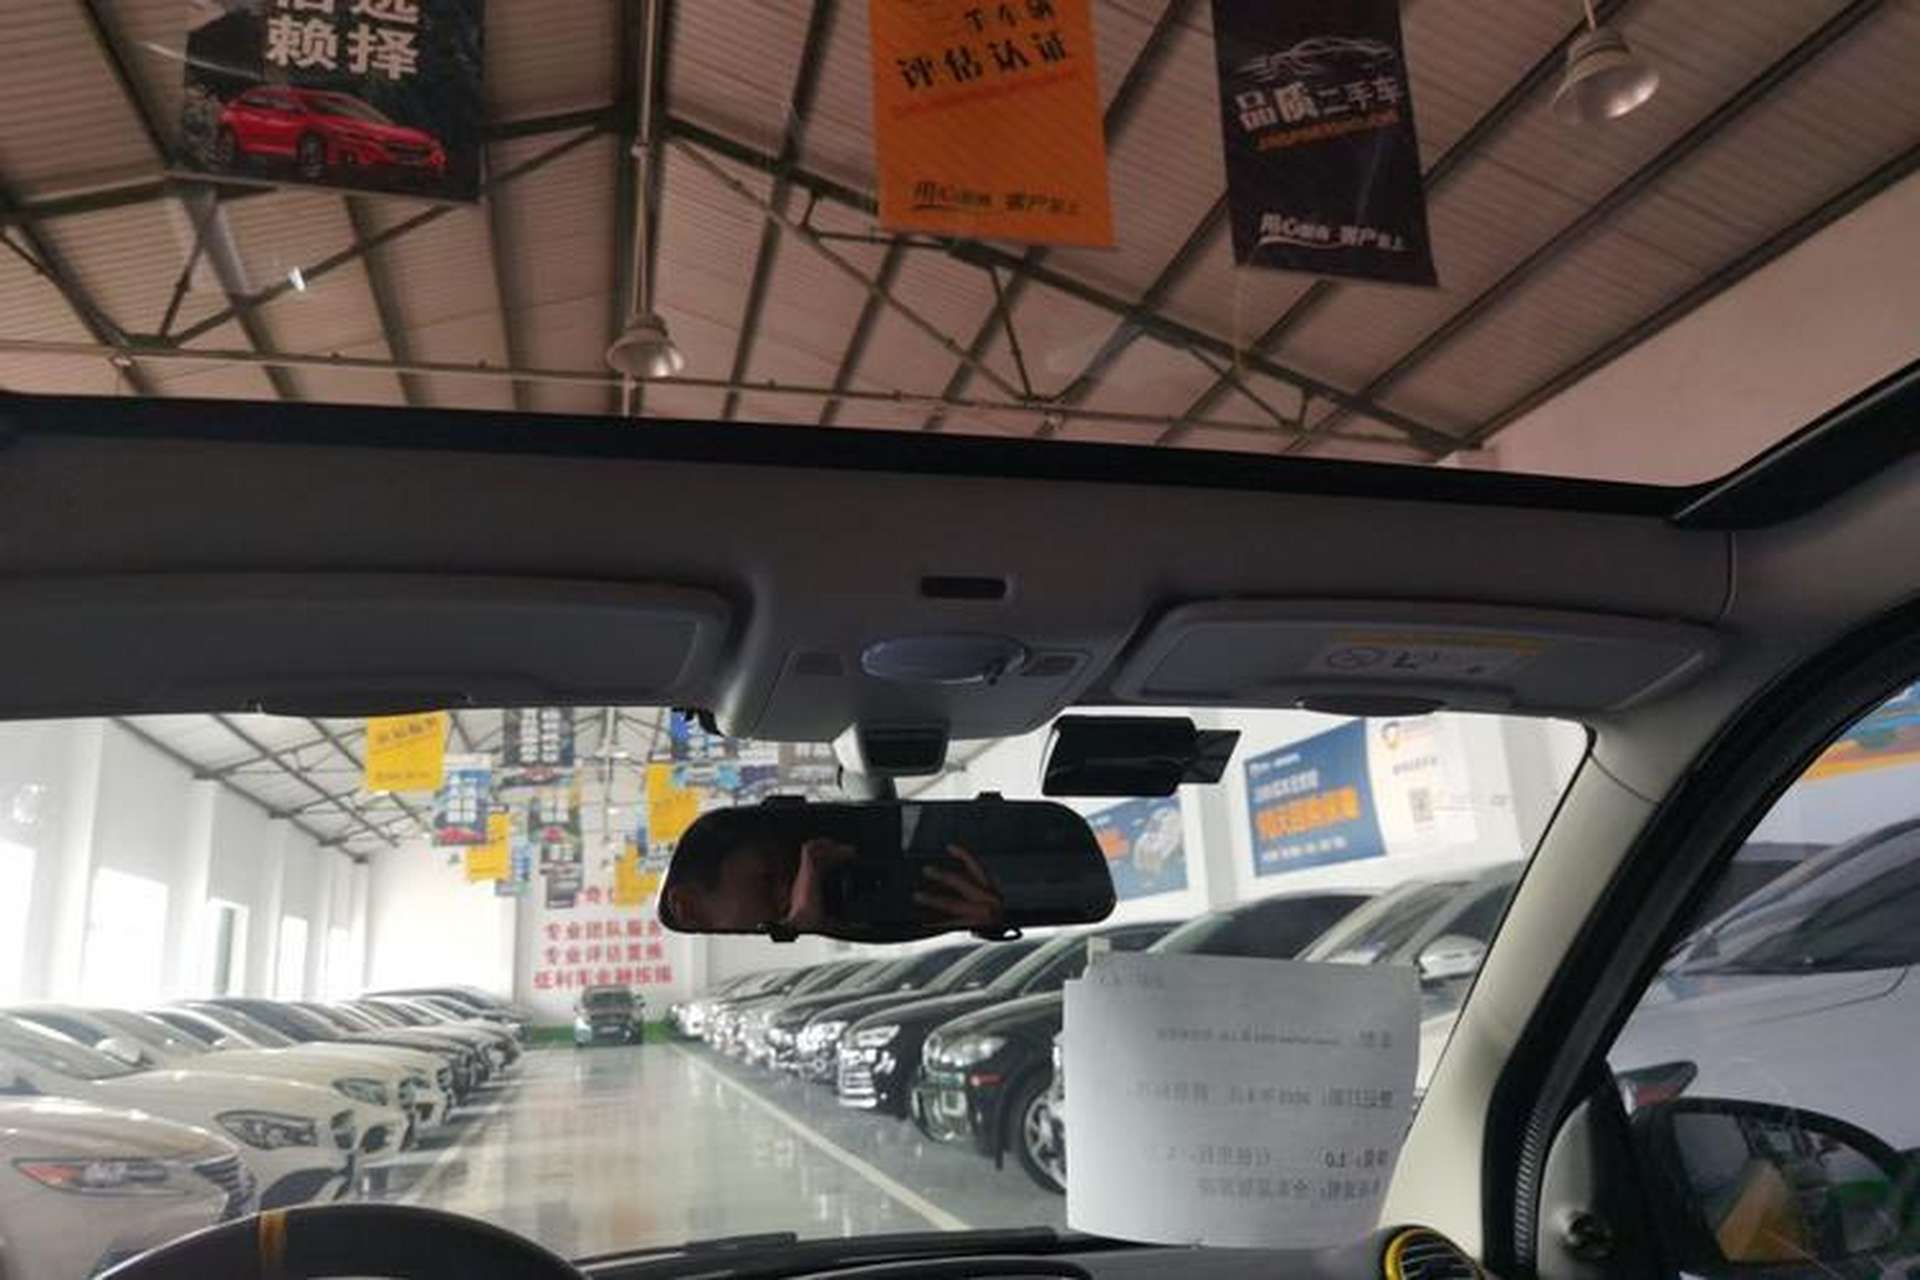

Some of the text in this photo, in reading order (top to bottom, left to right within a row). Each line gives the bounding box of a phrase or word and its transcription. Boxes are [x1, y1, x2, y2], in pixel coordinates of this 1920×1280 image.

[896, 29, 1069, 92] 评估认证
[1234, 76, 1403, 133] 品质二手车
